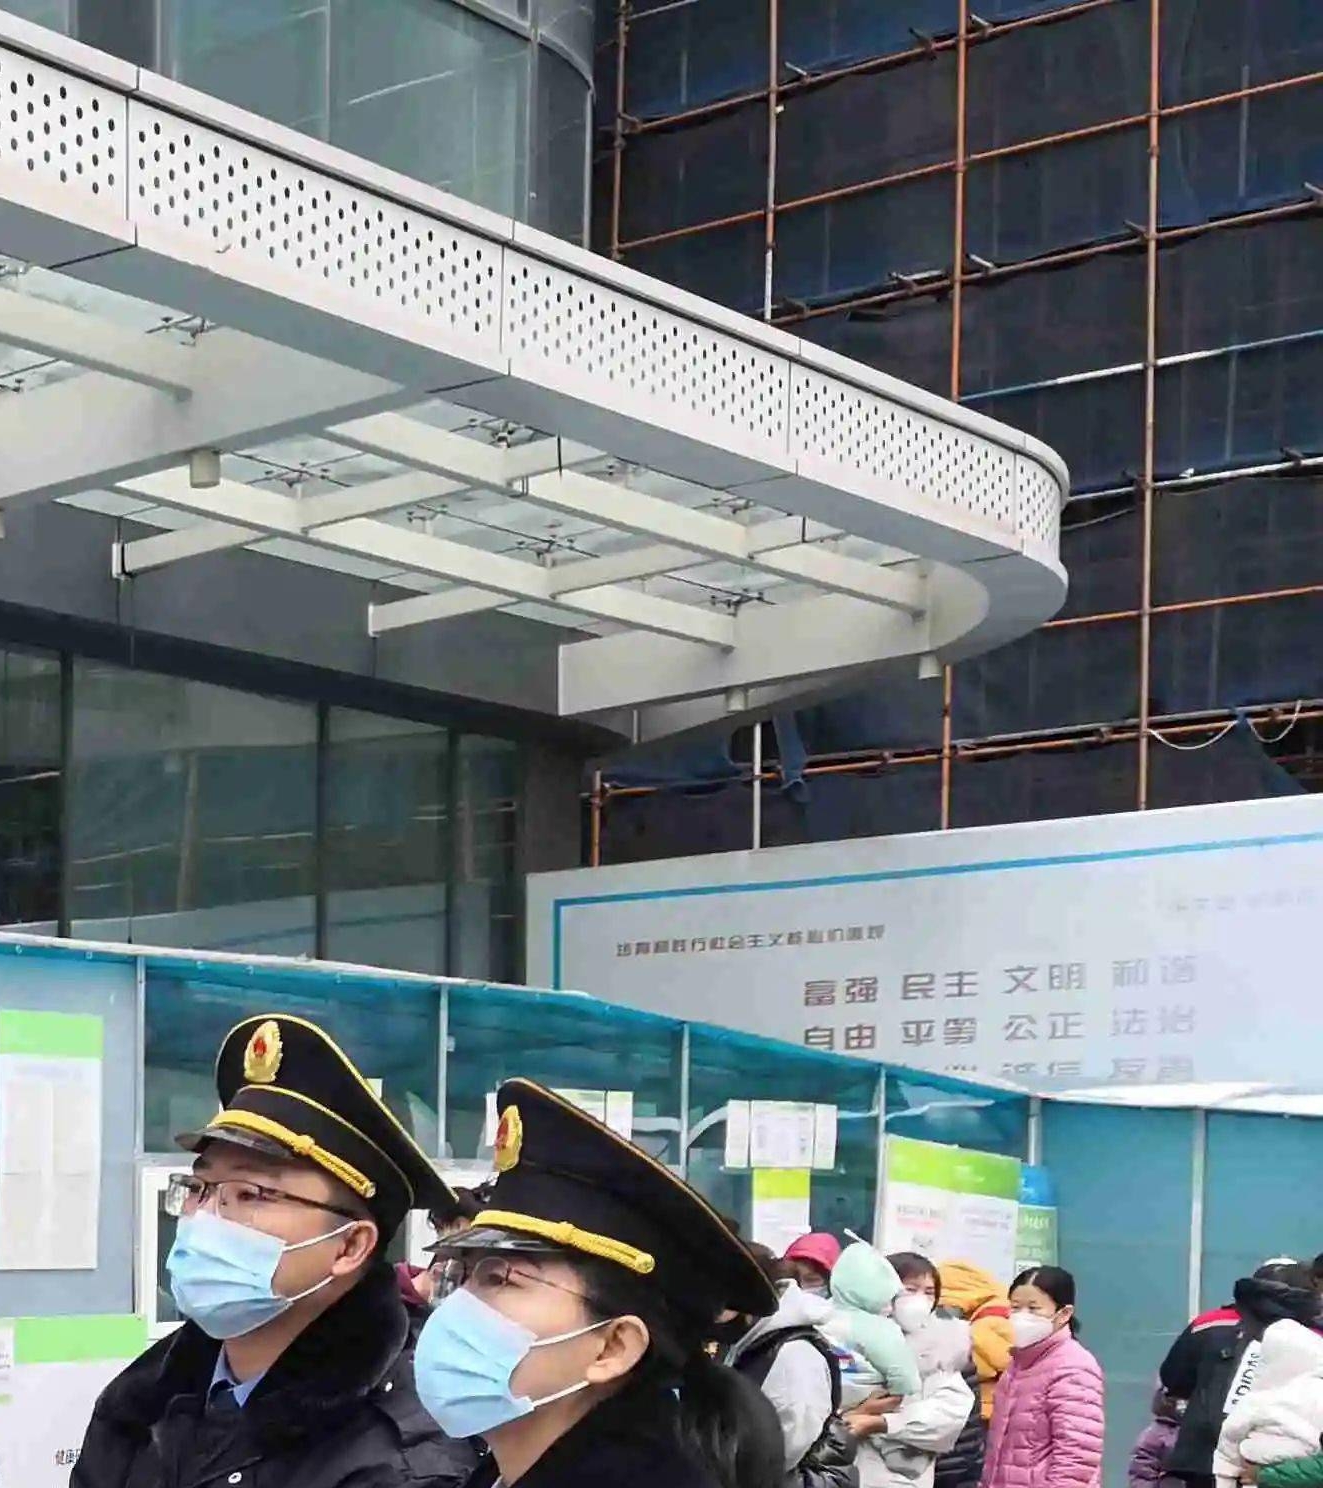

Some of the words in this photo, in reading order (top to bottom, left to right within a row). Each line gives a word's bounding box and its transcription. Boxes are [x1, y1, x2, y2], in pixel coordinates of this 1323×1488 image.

[804, 977, 878, 1006] 富强
[901, 970, 979, 1001] 民主
[1003, 962, 1086, 995] 文明
[1112, 955, 1198, 987] 和谐
[804, 1024, 876, 1051] 自由
[901, 1017, 977, 1048] 平等
[1003, 1011, 1084, 1042] 公正
[1112, 1004, 1196, 1036] 法治
